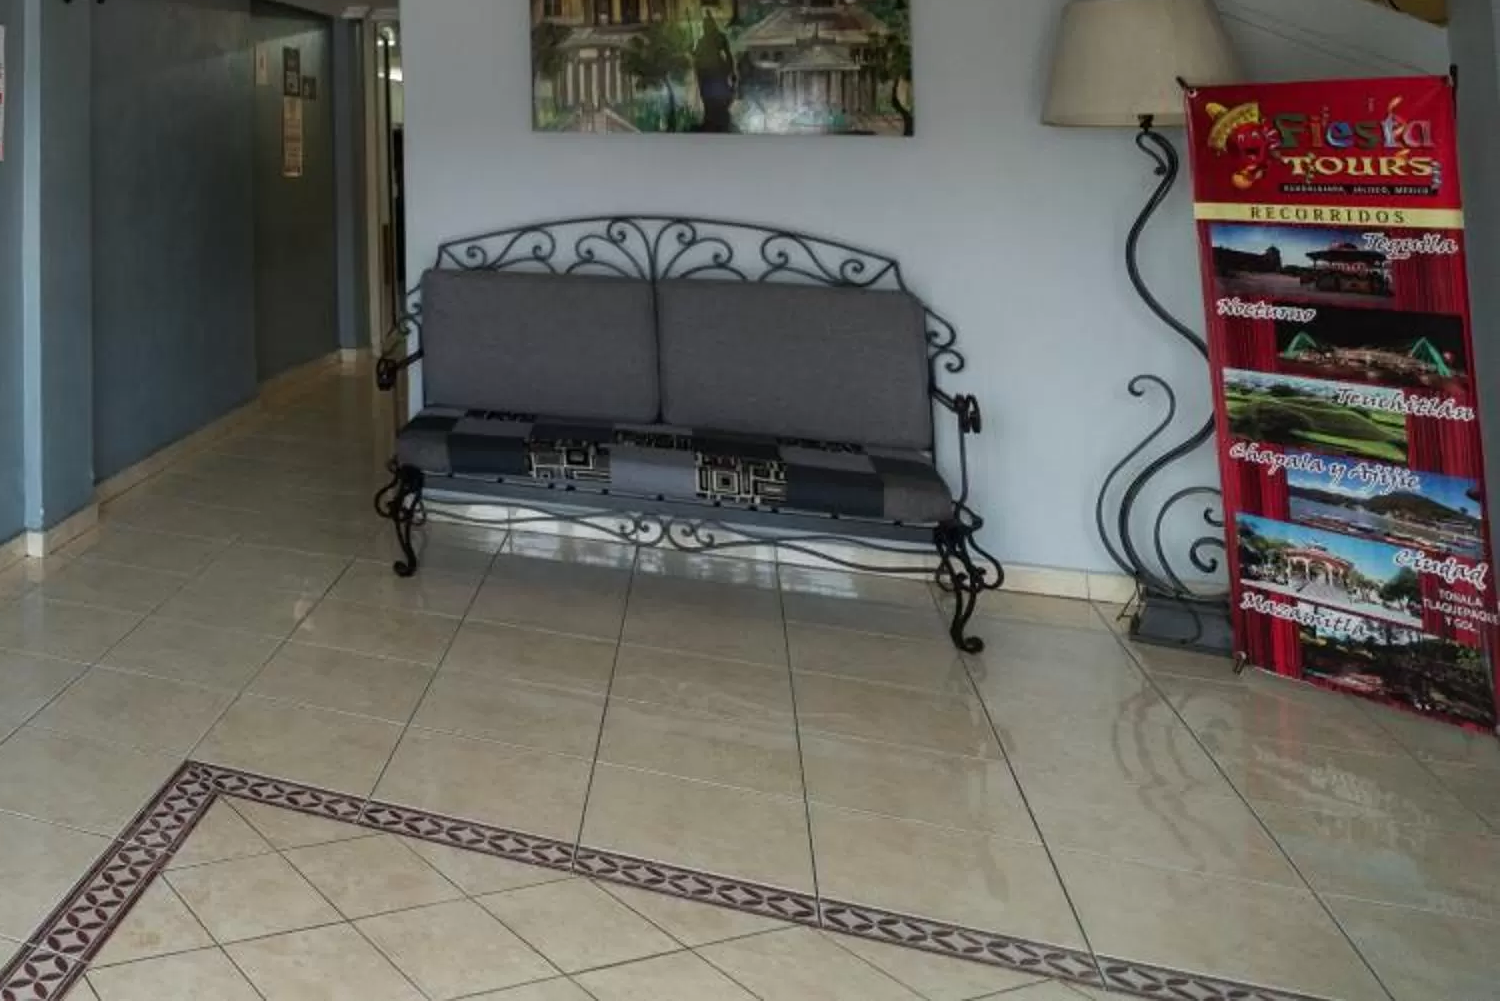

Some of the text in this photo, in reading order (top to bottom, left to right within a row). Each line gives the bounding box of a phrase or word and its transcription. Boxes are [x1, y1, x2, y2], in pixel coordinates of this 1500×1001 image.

[1274, 111, 1435, 148] Fiesta
[1280, 155, 1434, 176] TOURS
[1249, 206, 1406, 224] RECORRIDOS
[1362, 232, 1459, 260] Tequila
[1216, 297, 1317, 322] Nocturno
[1229, 442, 1326, 476] Chapala
[1327, 462, 1349, 485] y
[1393, 549, 1489, 590] Ciudad
[1239, 591, 1372, 639] Mazamitla
